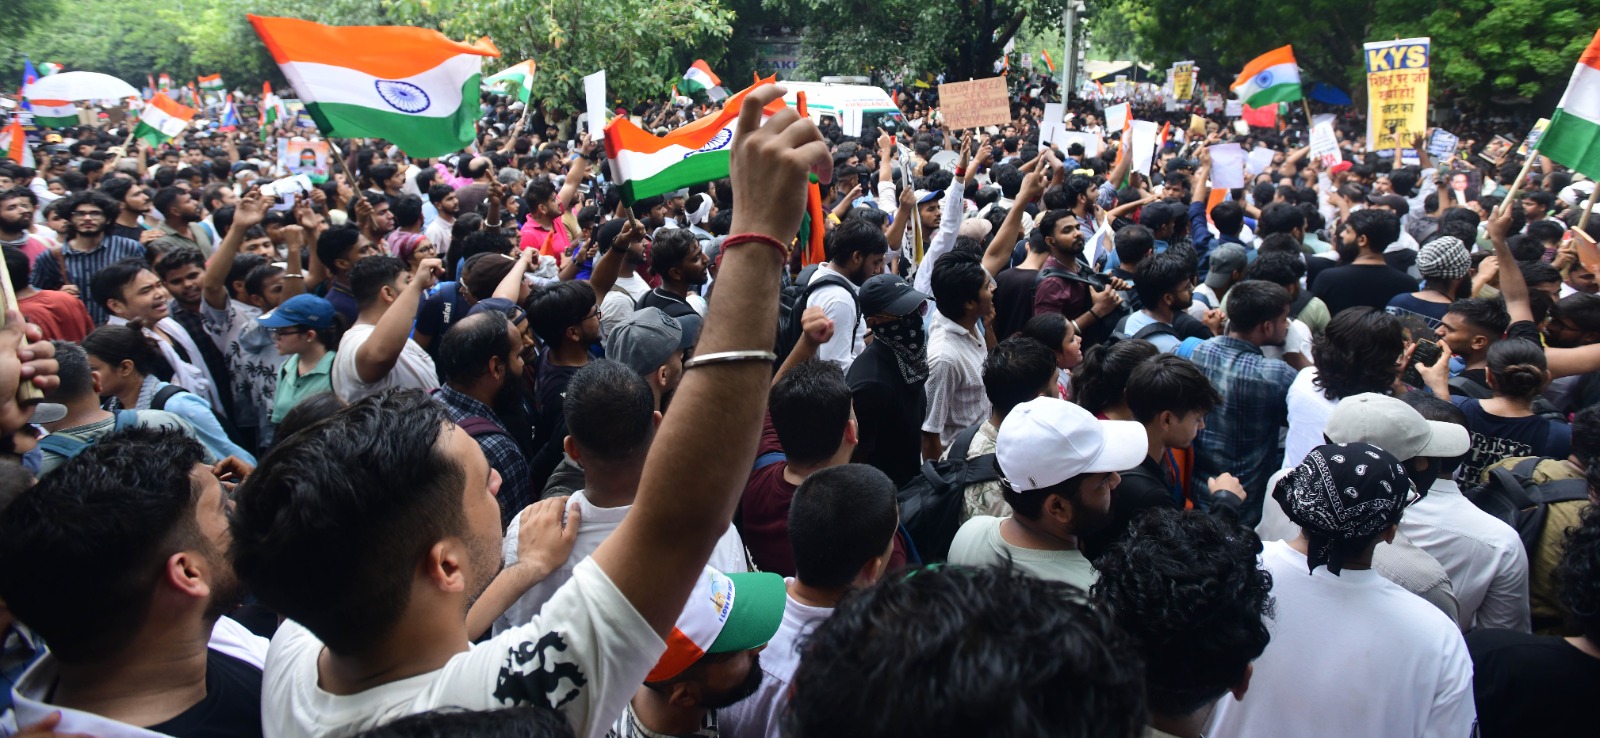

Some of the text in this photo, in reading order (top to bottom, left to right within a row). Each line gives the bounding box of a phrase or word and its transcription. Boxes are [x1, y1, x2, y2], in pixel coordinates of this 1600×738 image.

[1368, 45, 1426, 72] KYS
[979, 79, 1001, 91] NEED
[442, 302, 452, 324] safari
[721, 601, 730, 618] LOVE
